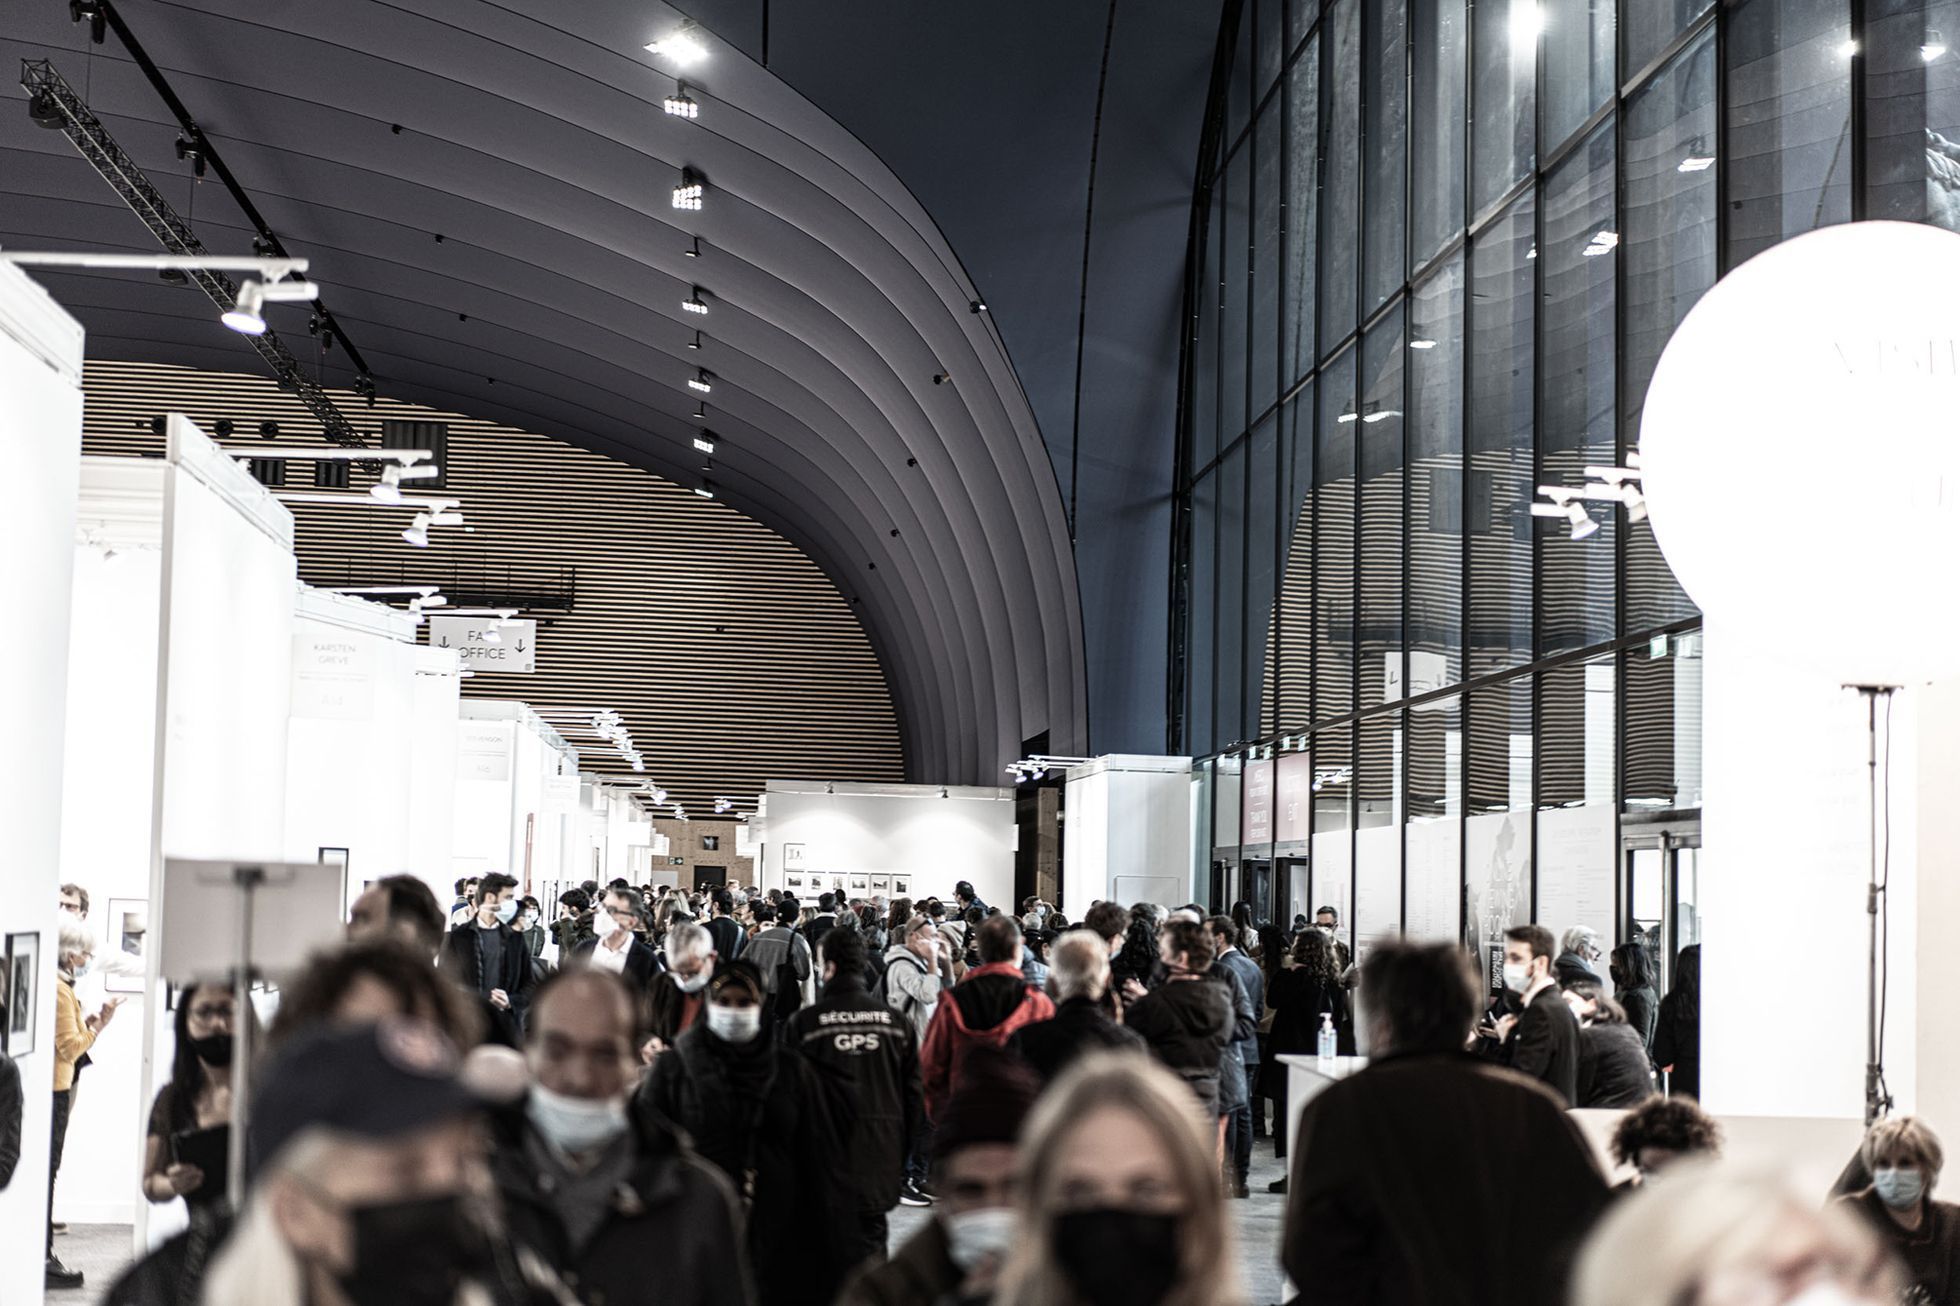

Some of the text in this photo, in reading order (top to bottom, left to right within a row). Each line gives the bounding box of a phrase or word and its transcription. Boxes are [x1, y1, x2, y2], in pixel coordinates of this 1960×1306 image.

[459, 647, 506, 659] OFFICE
[819, 1010, 892, 1025] SÉCURITÉ
[834, 1033, 880, 1051] GPS
